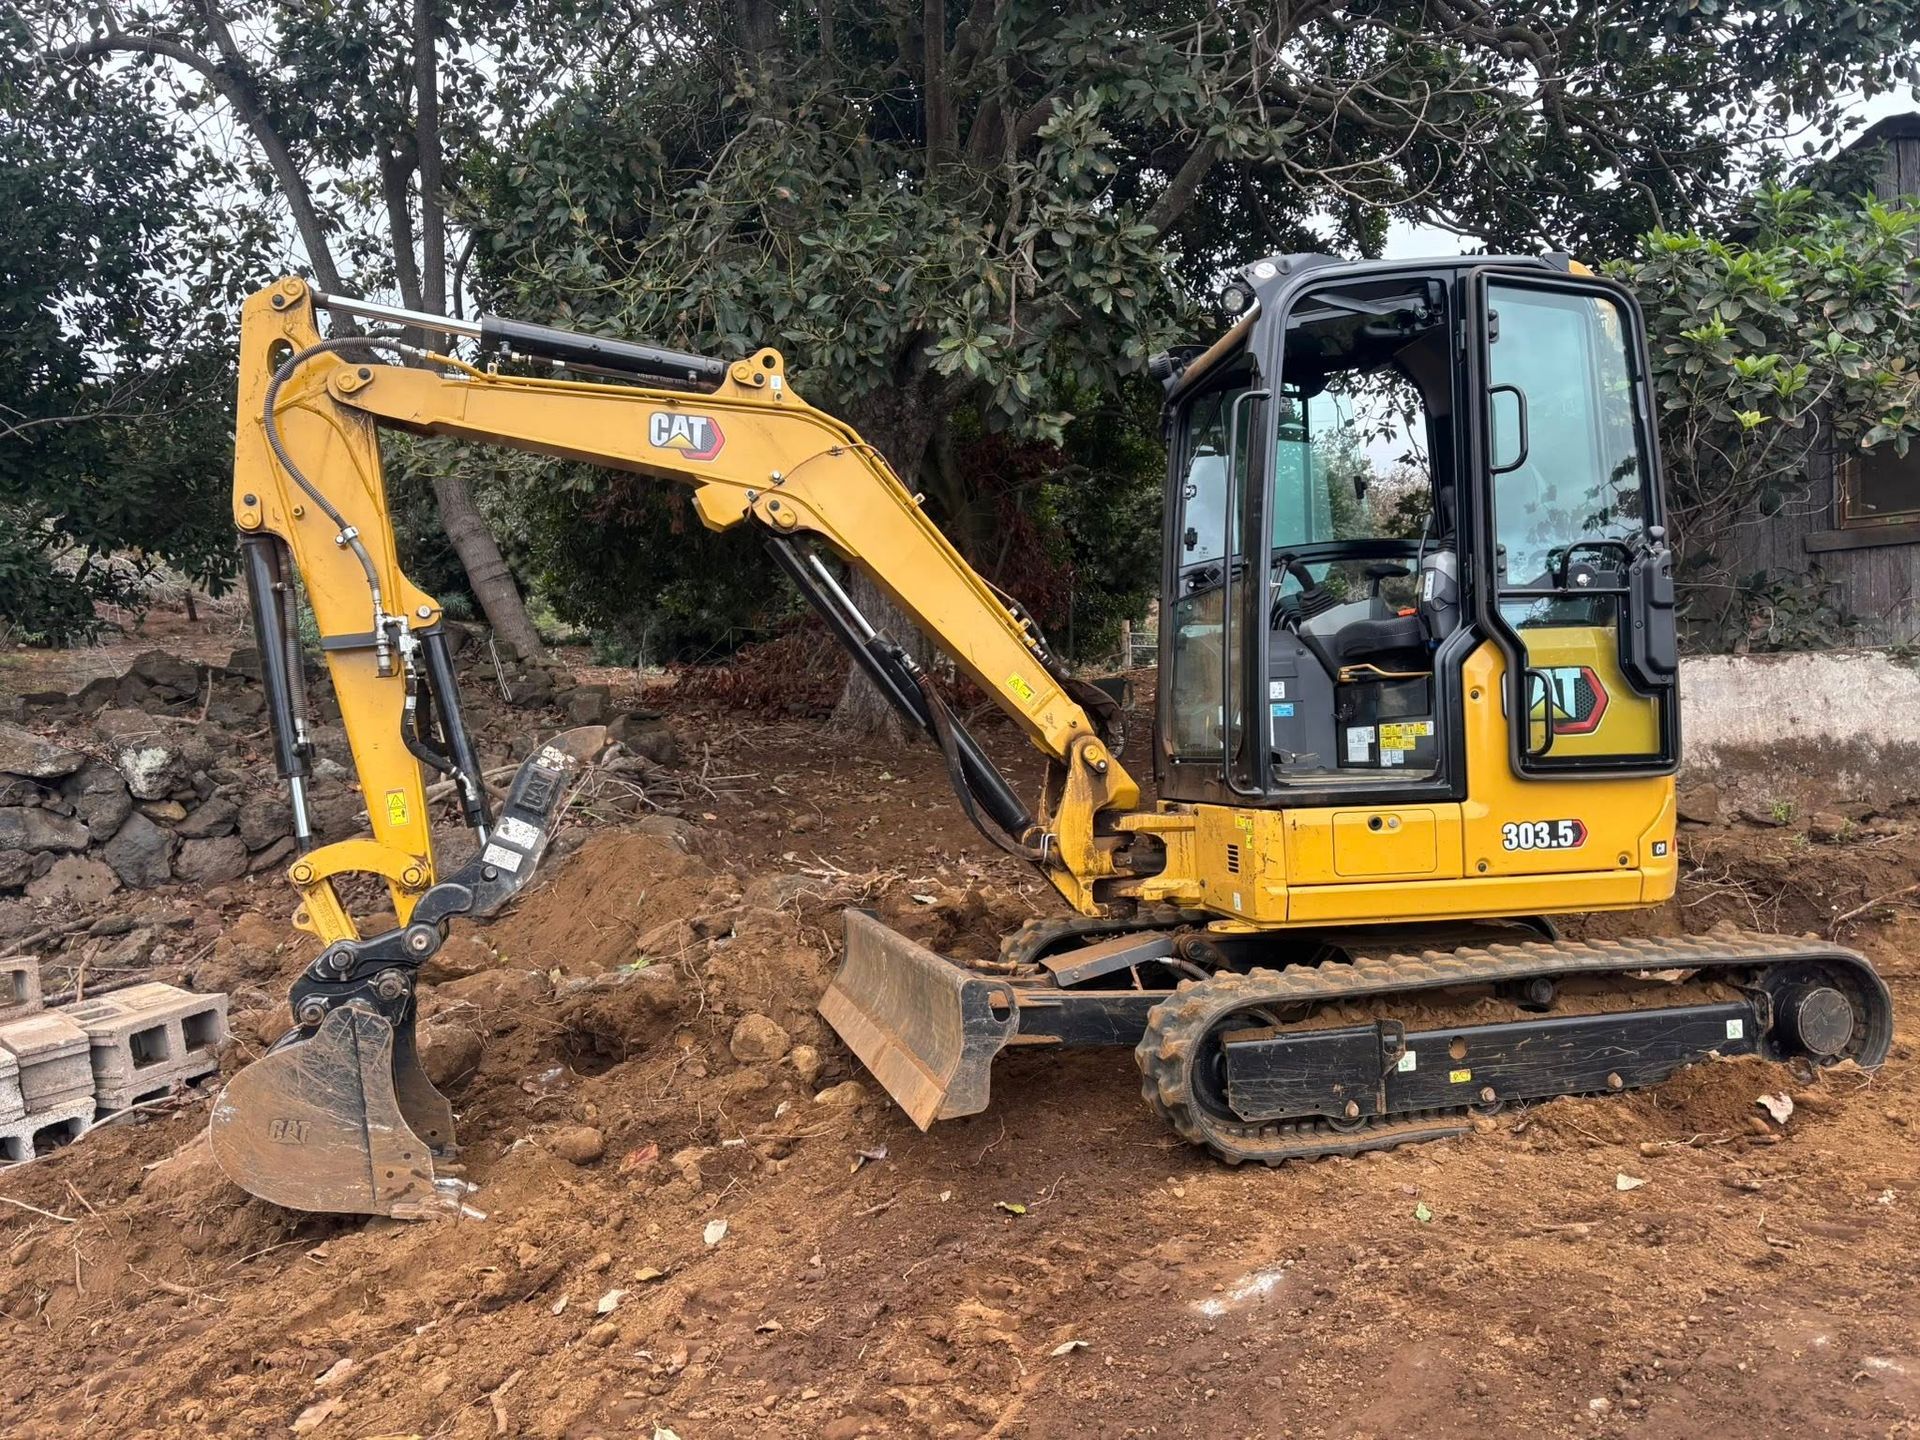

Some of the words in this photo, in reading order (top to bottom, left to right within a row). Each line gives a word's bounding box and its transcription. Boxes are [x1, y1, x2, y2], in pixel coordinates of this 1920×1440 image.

[650, 412, 707, 450] CAT
[1502, 667, 1581, 718] AT
[520, 771, 552, 807] CAT
[1502, 820, 1574, 850] 303.5
[269, 1118, 312, 1145] CAT
